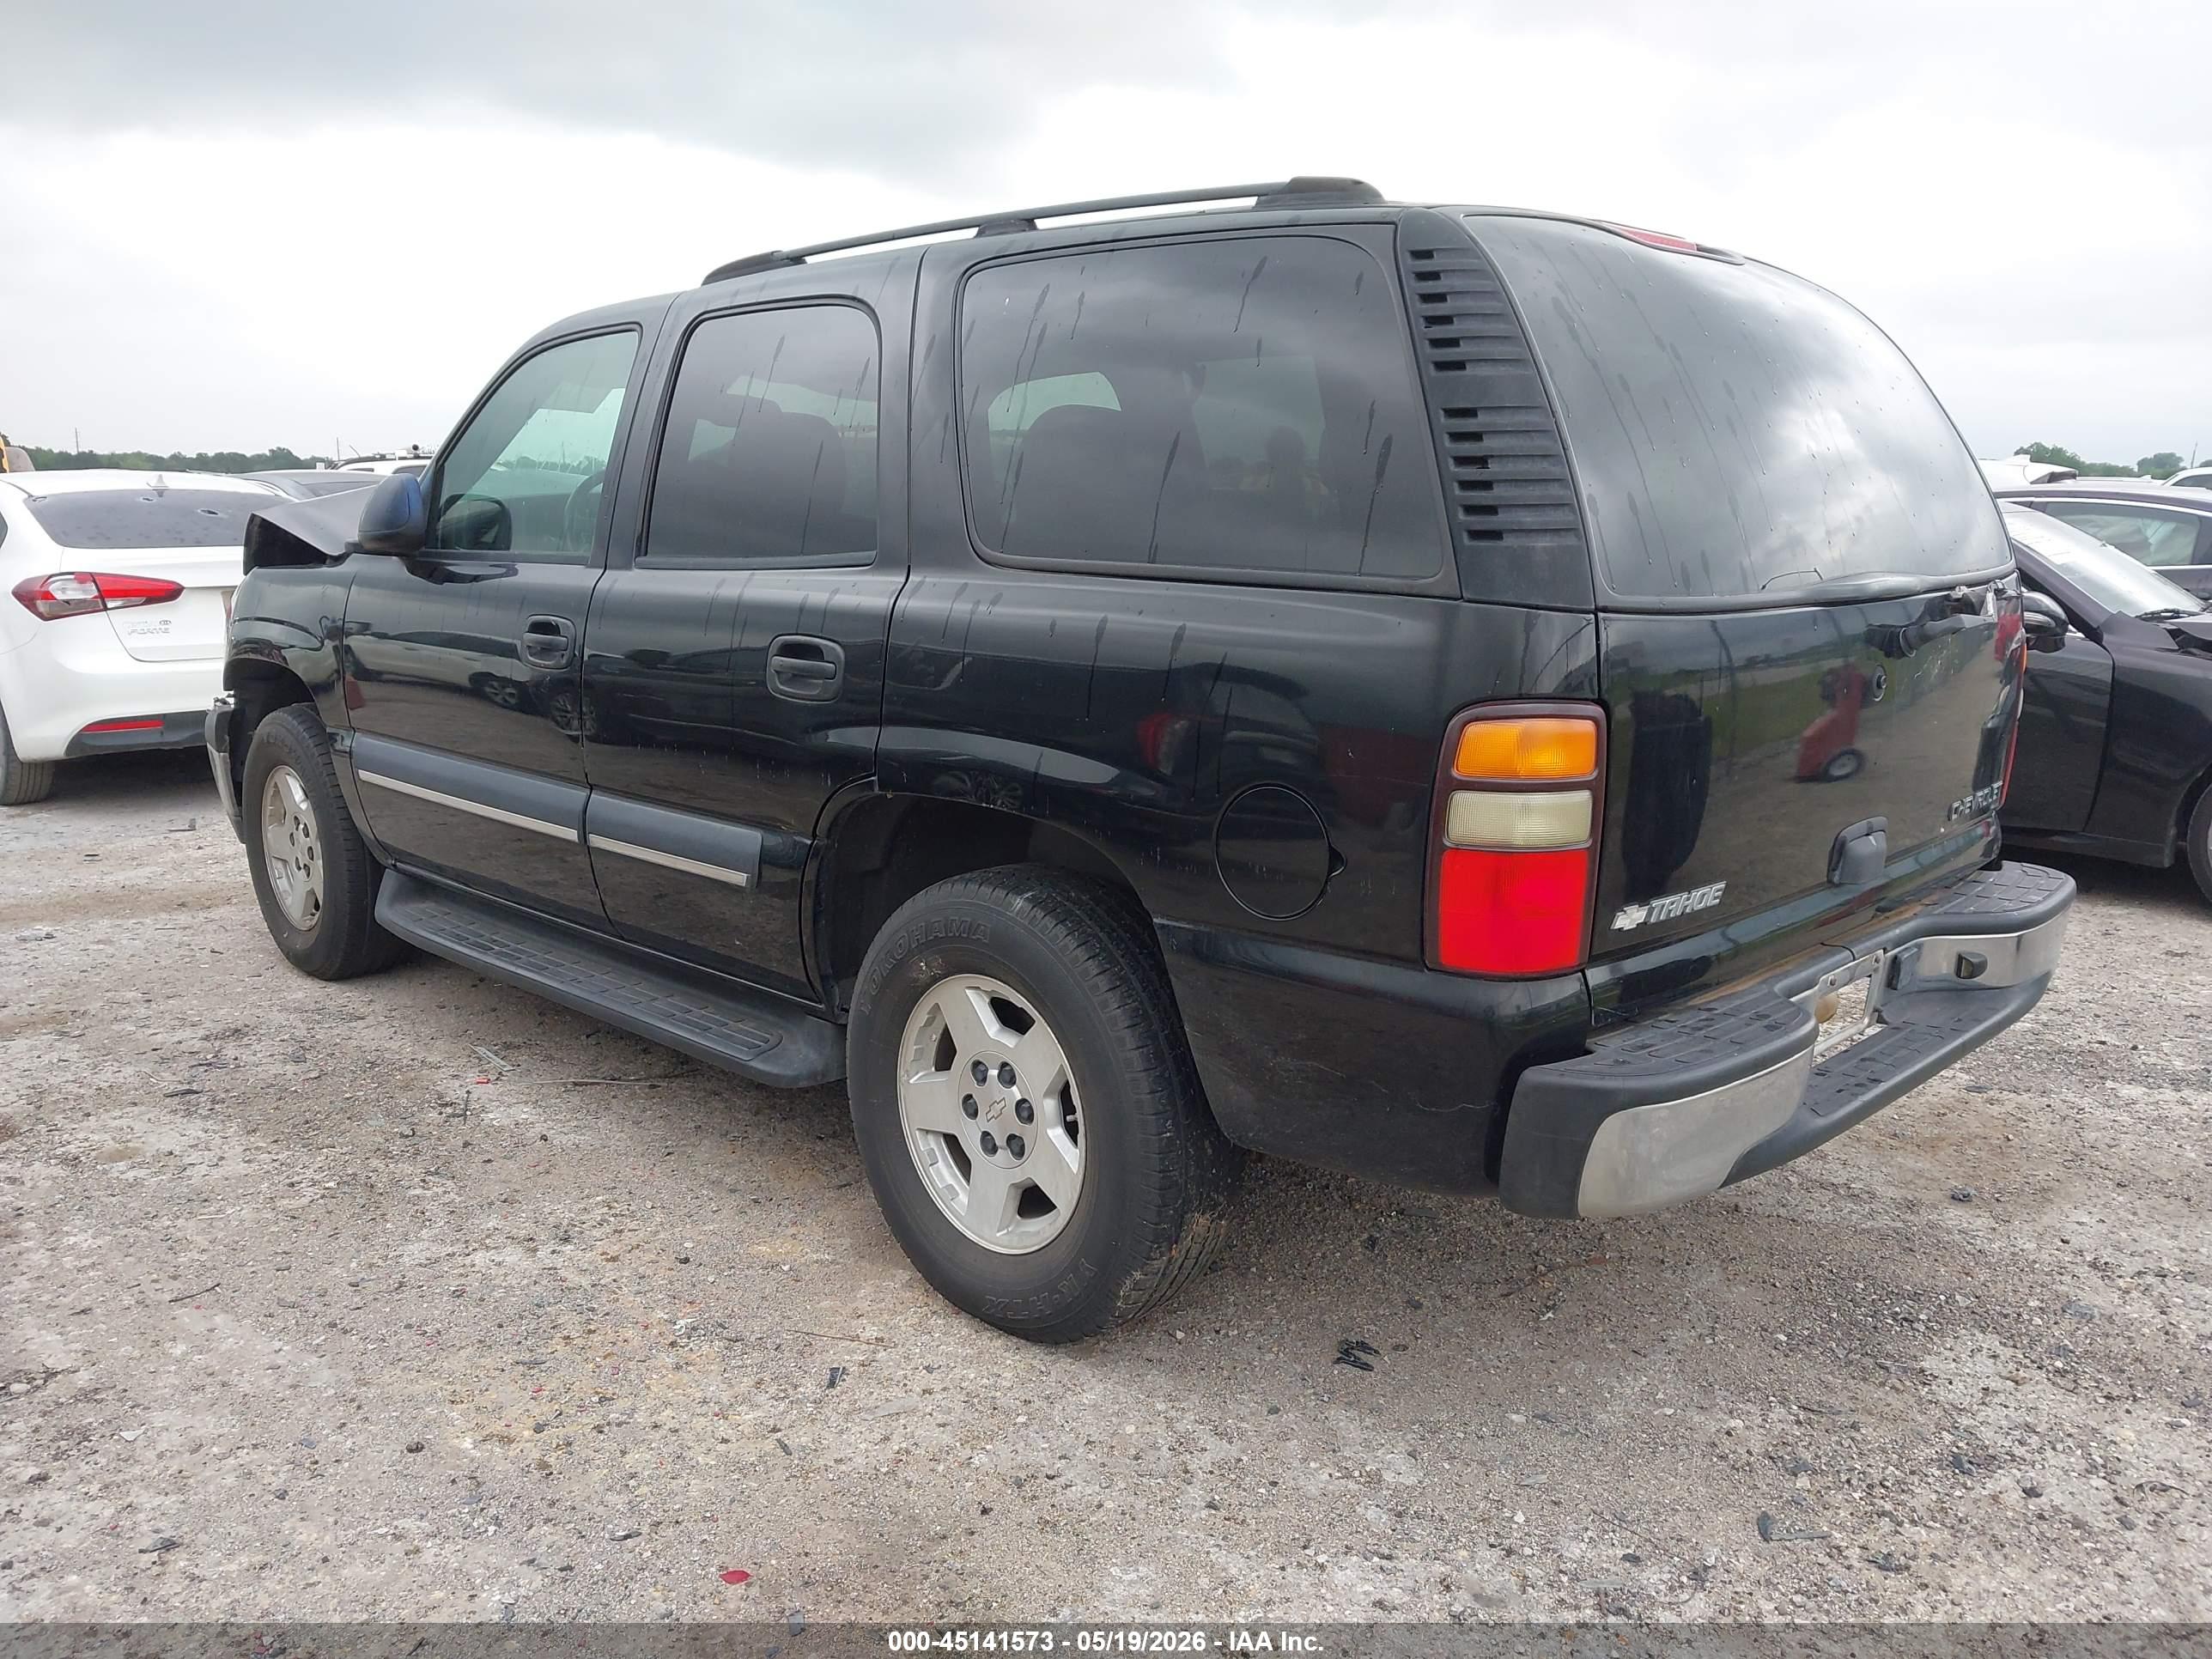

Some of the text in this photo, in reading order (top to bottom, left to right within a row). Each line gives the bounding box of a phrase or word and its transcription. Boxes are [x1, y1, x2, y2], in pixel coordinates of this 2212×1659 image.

[1951, 781, 2003, 820] CHEVROLET
[1647, 880, 1727, 924] TAHOE
[859, 915, 992, 1017] YOKOHAMA
